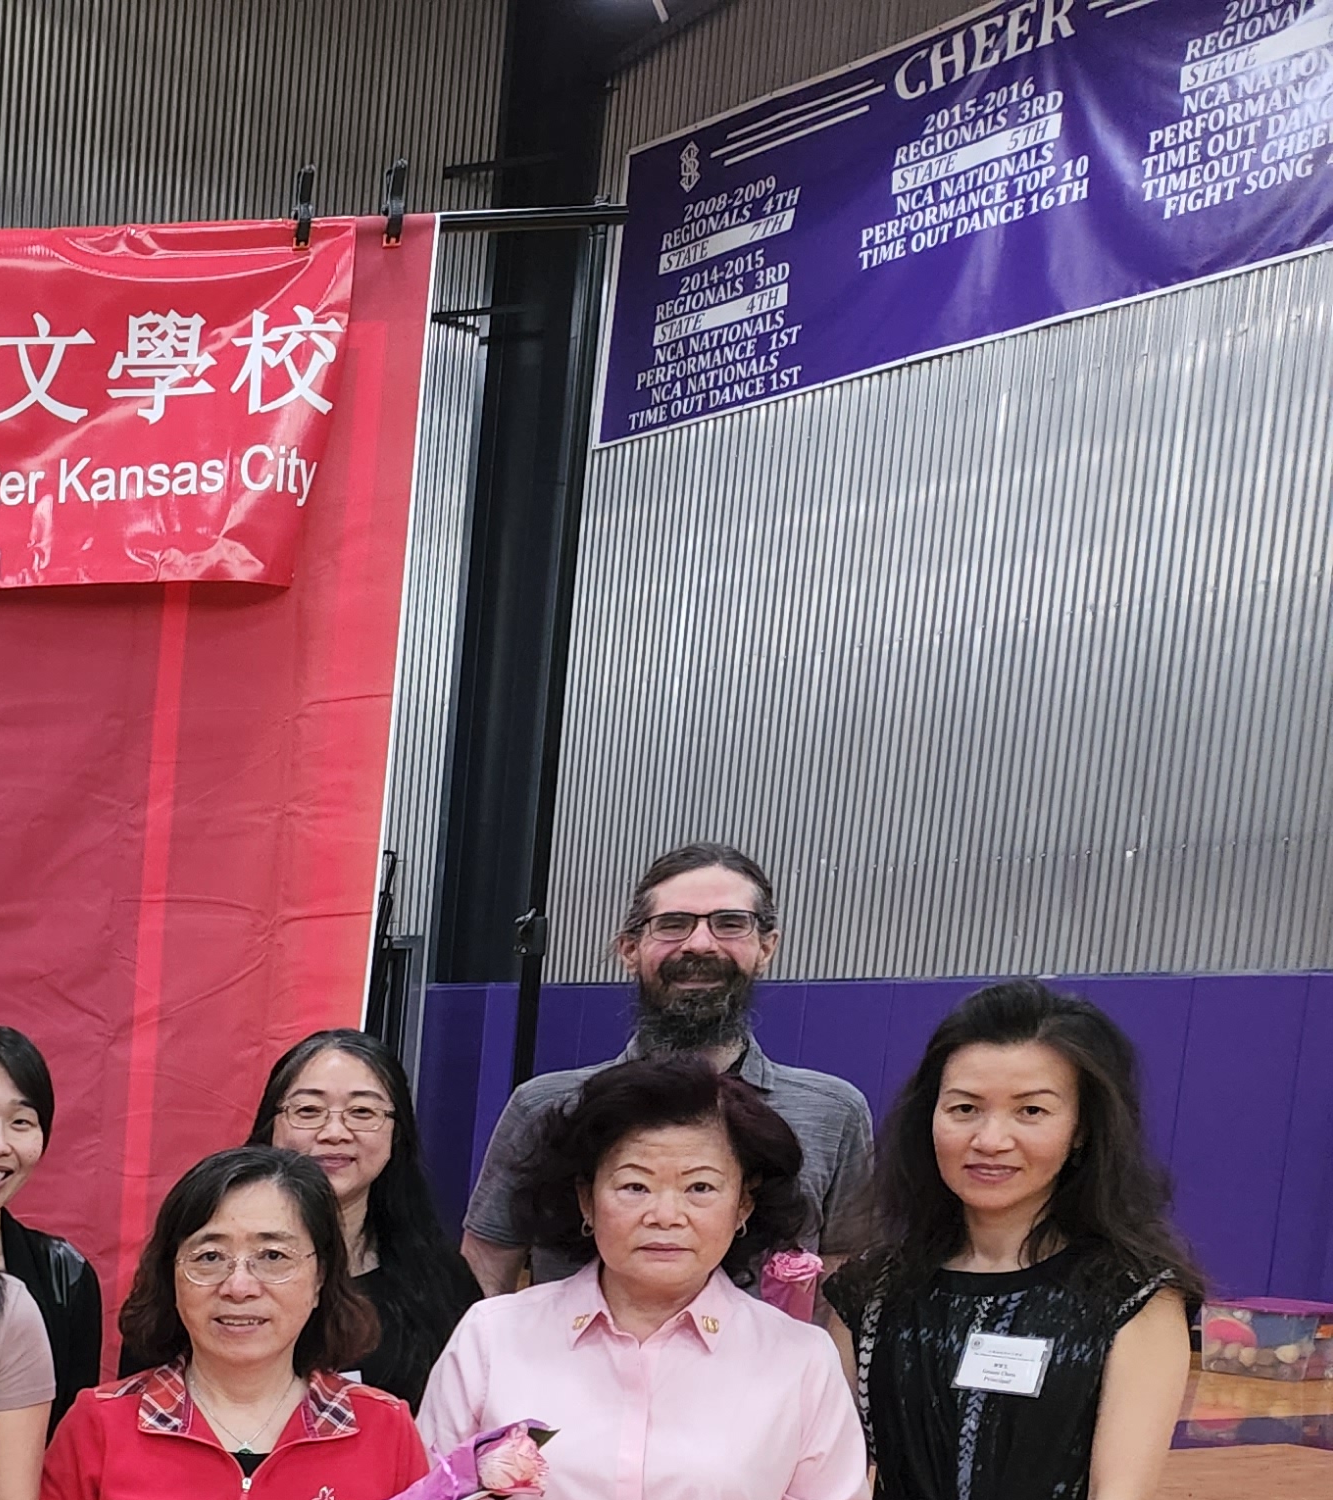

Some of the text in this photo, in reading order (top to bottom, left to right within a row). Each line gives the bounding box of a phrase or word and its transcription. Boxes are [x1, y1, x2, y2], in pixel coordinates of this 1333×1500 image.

[895, 0, 1075, 100] CHEER
[1186, 42, 1261, 89] STATE
[893, 90, 1063, 168] REGIONALS 3RD
[922, 76, 1035, 136] 2015-2016
[1182, 81, 1231, 117] NCA
[895, 142, 1054, 216] NCA NATIONALS
[898, 119, 1050, 190] STATE 5TH
[1142, 141, 1202, 179] TIME
[1207, 120, 1261, 157] OUT
[1142, 147, 1257, 201] TIMEOUT
[683, 175, 776, 223] 2008-2009
[861, 155, 1089, 249] PERFORMANCE TOP 10
[1164, 153, 1314, 220] FIGHT SONG
[661, 186, 801, 251] REGIONALS 4TH
[663, 213, 787, 272] STATE 7TH
[859, 178, 1090, 271] TIME OUT DANCE 16TH
[655, 262, 790, 323] REGIONALS 3RD
[679, 248, 765, 295] 2014-2015
[653, 310, 785, 366] NCA NATIONALS
[657, 287, 781, 342] STATE 4TH
[636, 325, 802, 391] PERFORMANCE 1ST
[651, 351, 780, 406] NCA NATIONALS
[628, 366, 802, 431] TIME OUT DANCE 1ST
[59, 457, 224, 504] Kansas
[240, 444, 318, 507] City
